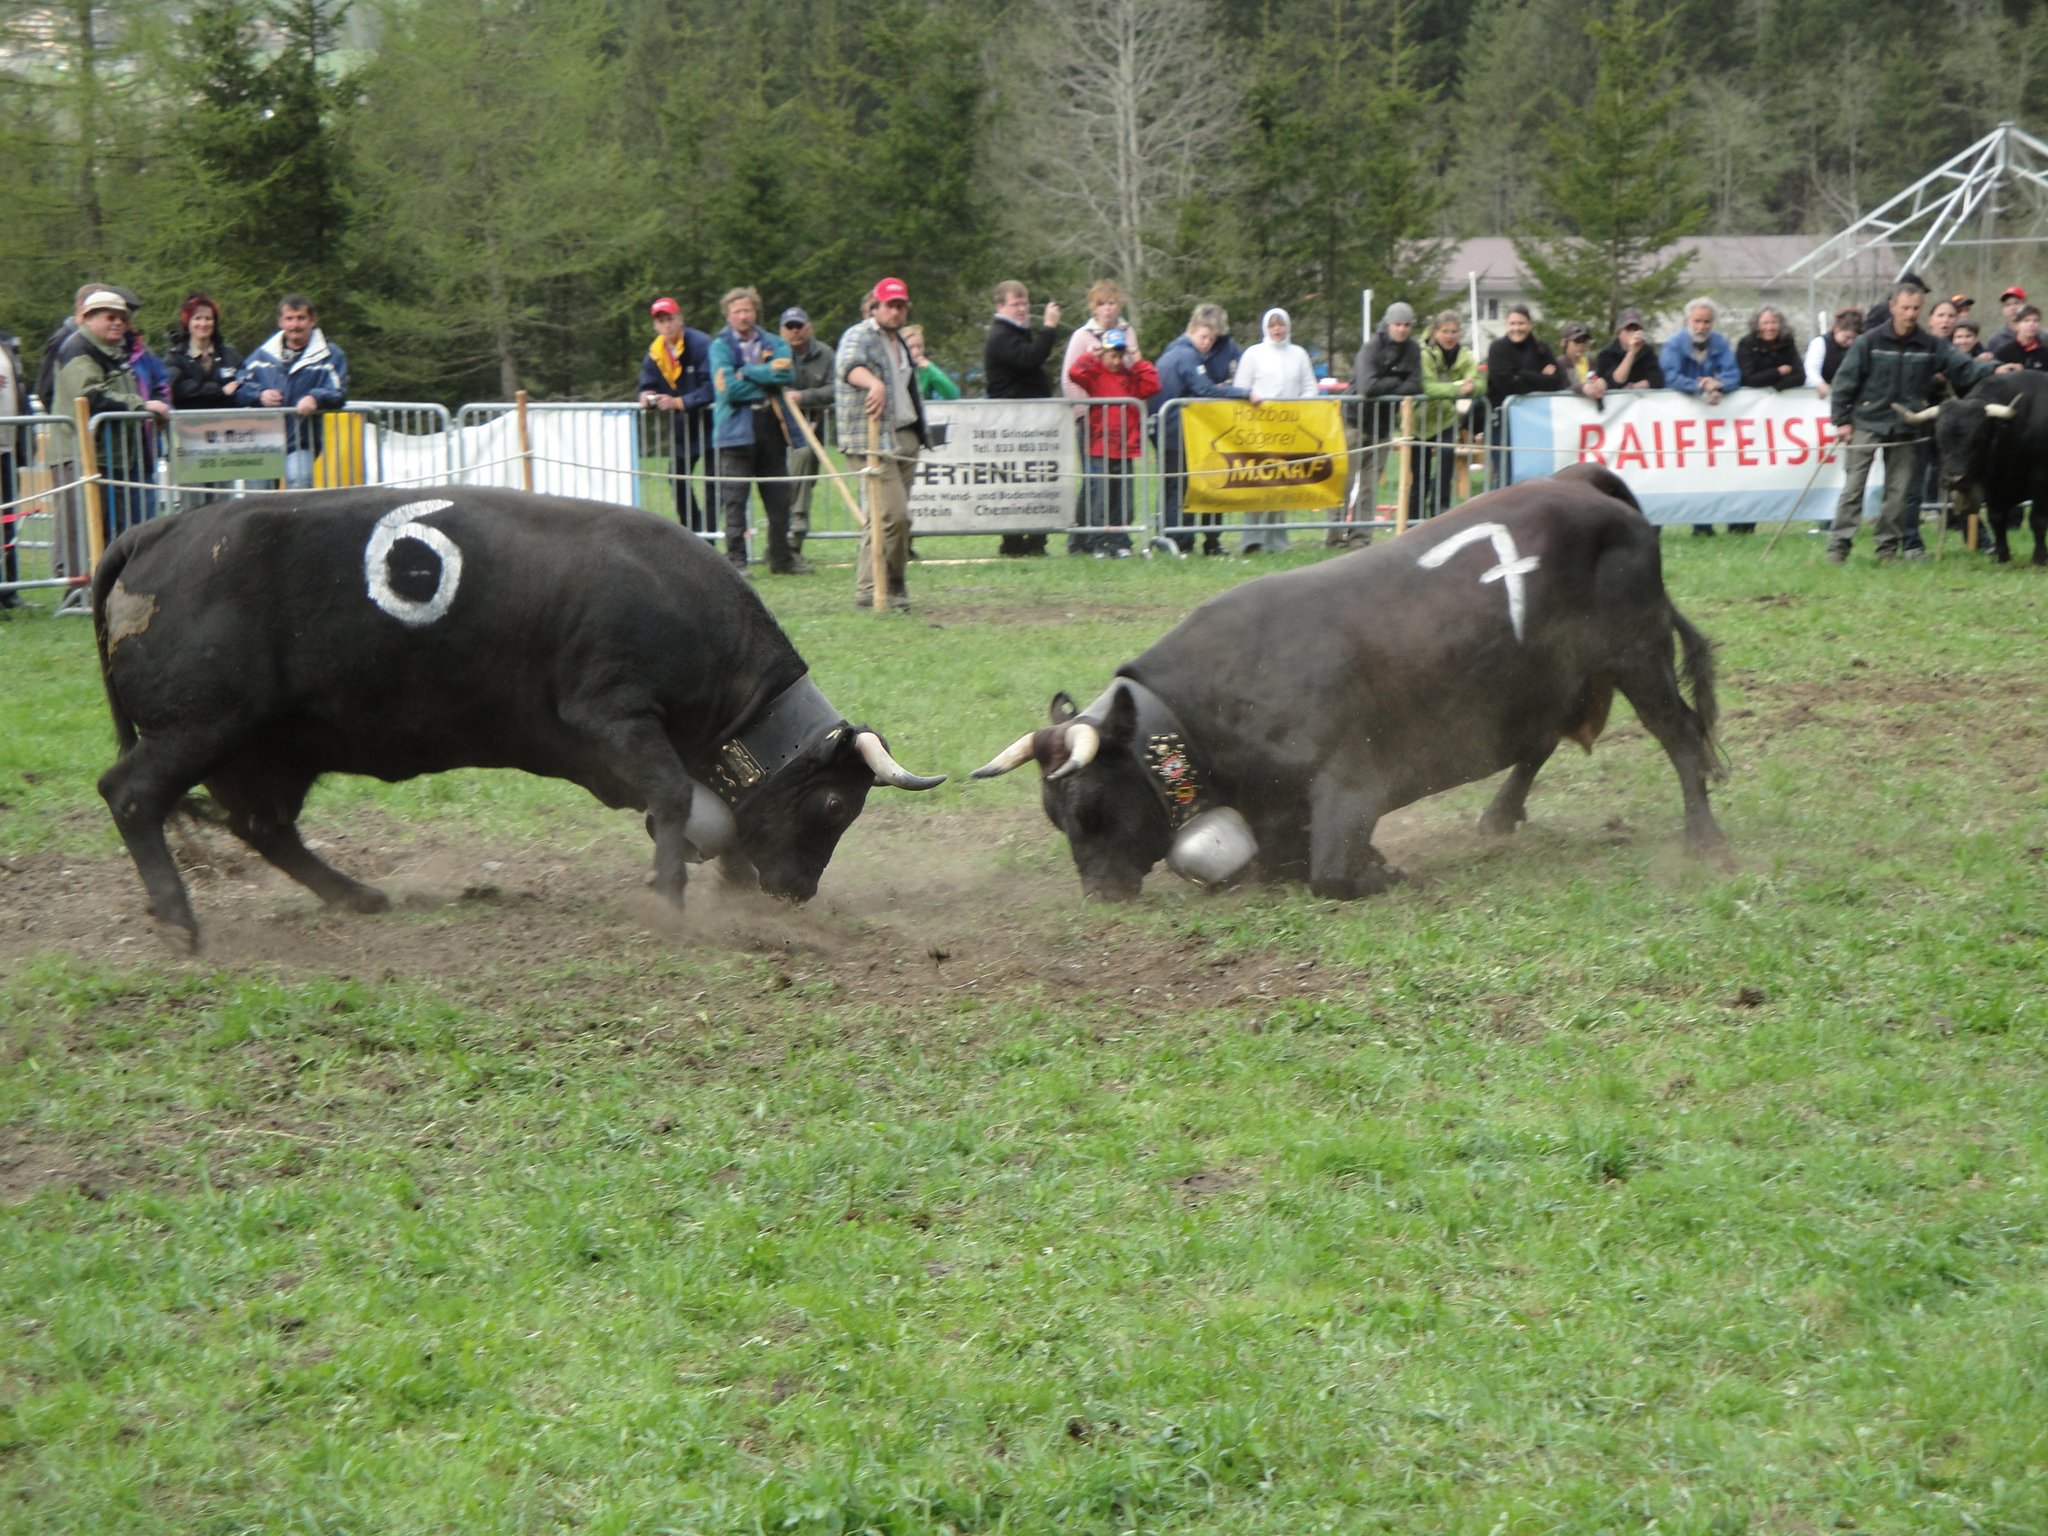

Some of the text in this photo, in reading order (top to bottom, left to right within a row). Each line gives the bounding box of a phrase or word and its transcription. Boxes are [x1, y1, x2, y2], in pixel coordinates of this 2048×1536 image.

[1576, 417, 1838, 470] RAIFFEISE
[365, 498, 463, 627] 6
[1417, 521, 1541, 643] 7
